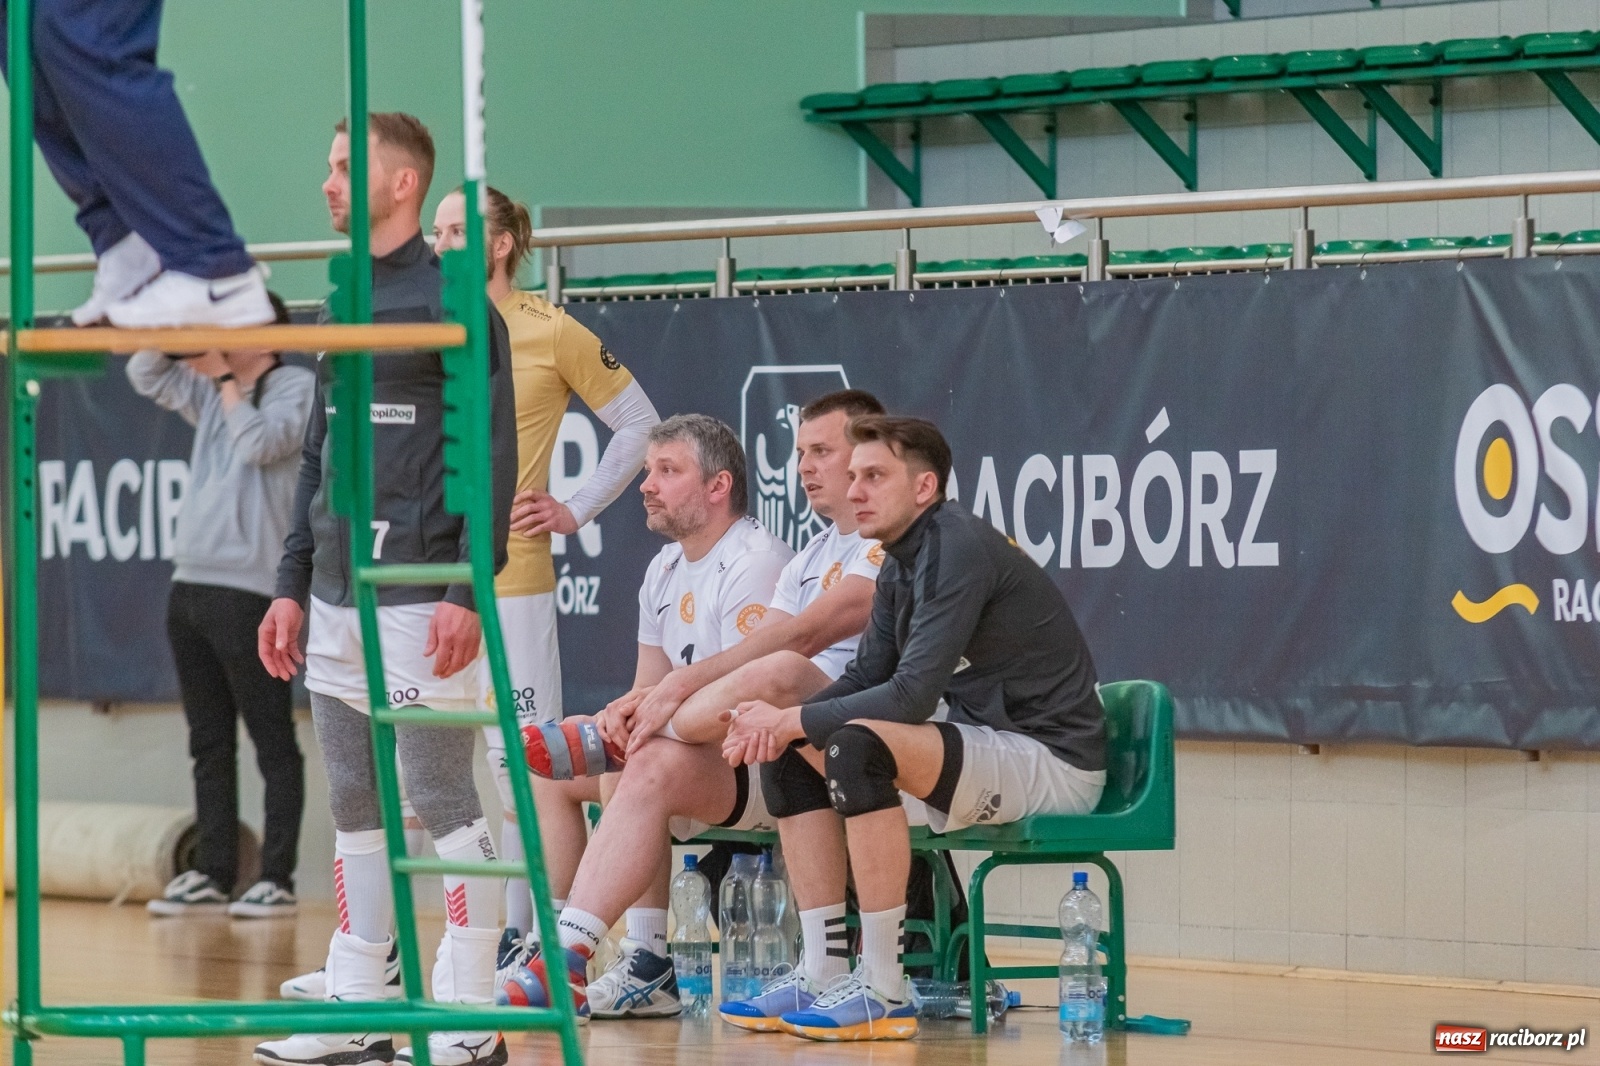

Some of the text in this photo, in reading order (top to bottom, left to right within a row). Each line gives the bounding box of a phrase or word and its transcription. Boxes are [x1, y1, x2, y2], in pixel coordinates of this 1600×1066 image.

[371, 407, 413, 420] opiDog
[945, 406, 1279, 569] ACIBÓRZ
[1454, 383, 1600, 555] OS
[38, 458, 192, 562] RACIB
[556, 562, 600, 614] ÓRZ
[511, 687, 535, 701] OO
[514, 700, 537, 712] AR
[559, 919, 600, 946] GIOCCA
